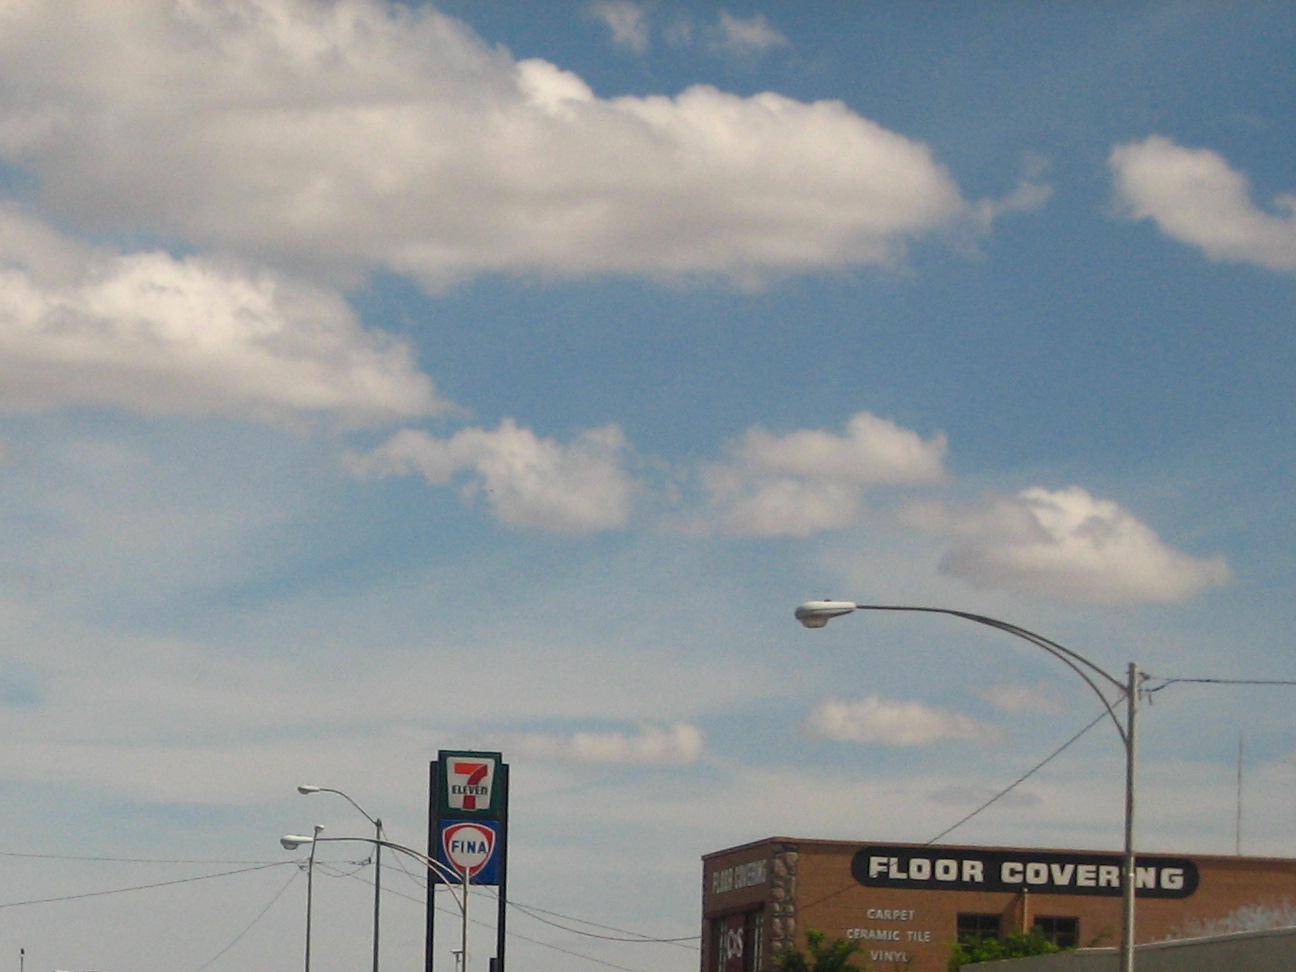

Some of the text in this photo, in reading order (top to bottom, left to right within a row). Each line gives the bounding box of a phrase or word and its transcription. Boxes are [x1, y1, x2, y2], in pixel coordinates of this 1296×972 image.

[454, 762, 488, 810] 7
[451, 840, 487, 854] FINA
[868, 855, 1185, 890] FLOOR COVERNG
[866, 908, 916, 921] CARPET
[846, 928, 932, 942] CERAMIC TILE
[870, 950, 909, 963] VINYL
